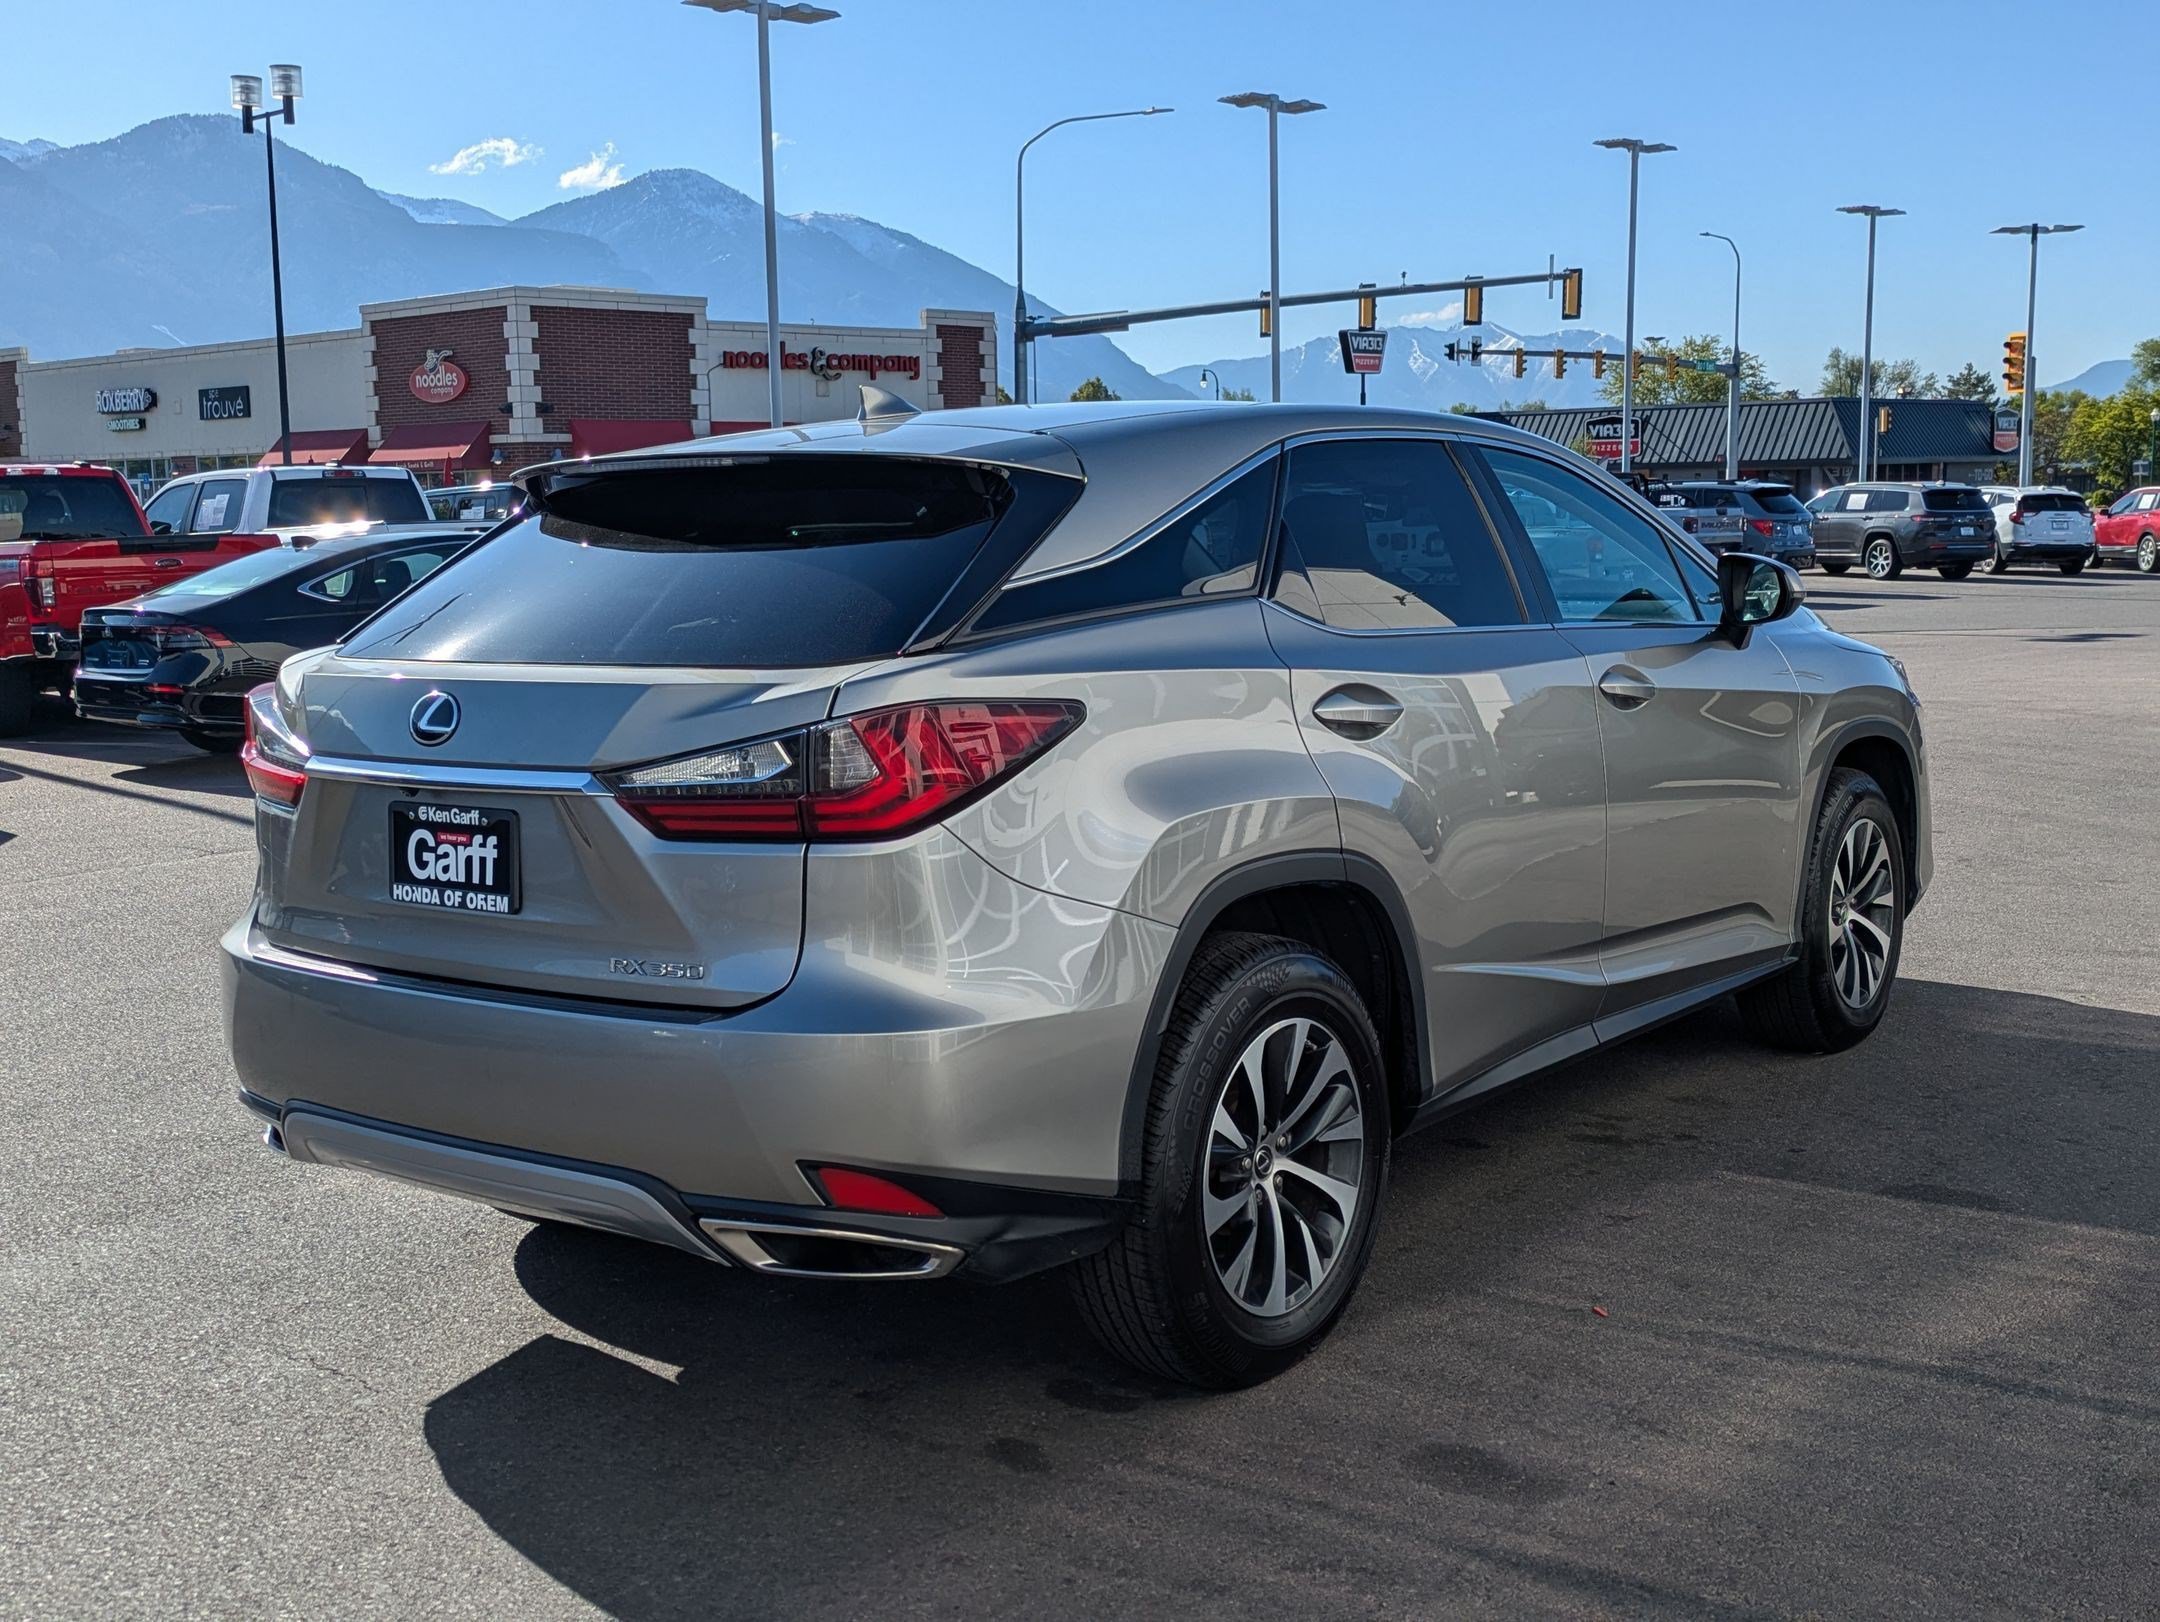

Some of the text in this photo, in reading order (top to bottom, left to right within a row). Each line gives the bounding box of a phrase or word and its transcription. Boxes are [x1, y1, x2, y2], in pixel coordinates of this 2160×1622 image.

[723, 341, 808, 369] nooles
[825, 353, 920, 381] company
[416, 365, 458, 388] noodles
[96, 388, 145, 413] ROXBERRY
[431, 386, 453, 396] company
[107, 418, 140, 431] SMOOTHIES
[407, 828, 498, 886] Garff
[393, 884, 509, 913] HONDA OF OREM
[1183, 996, 1252, 1131] CROSSOVER
